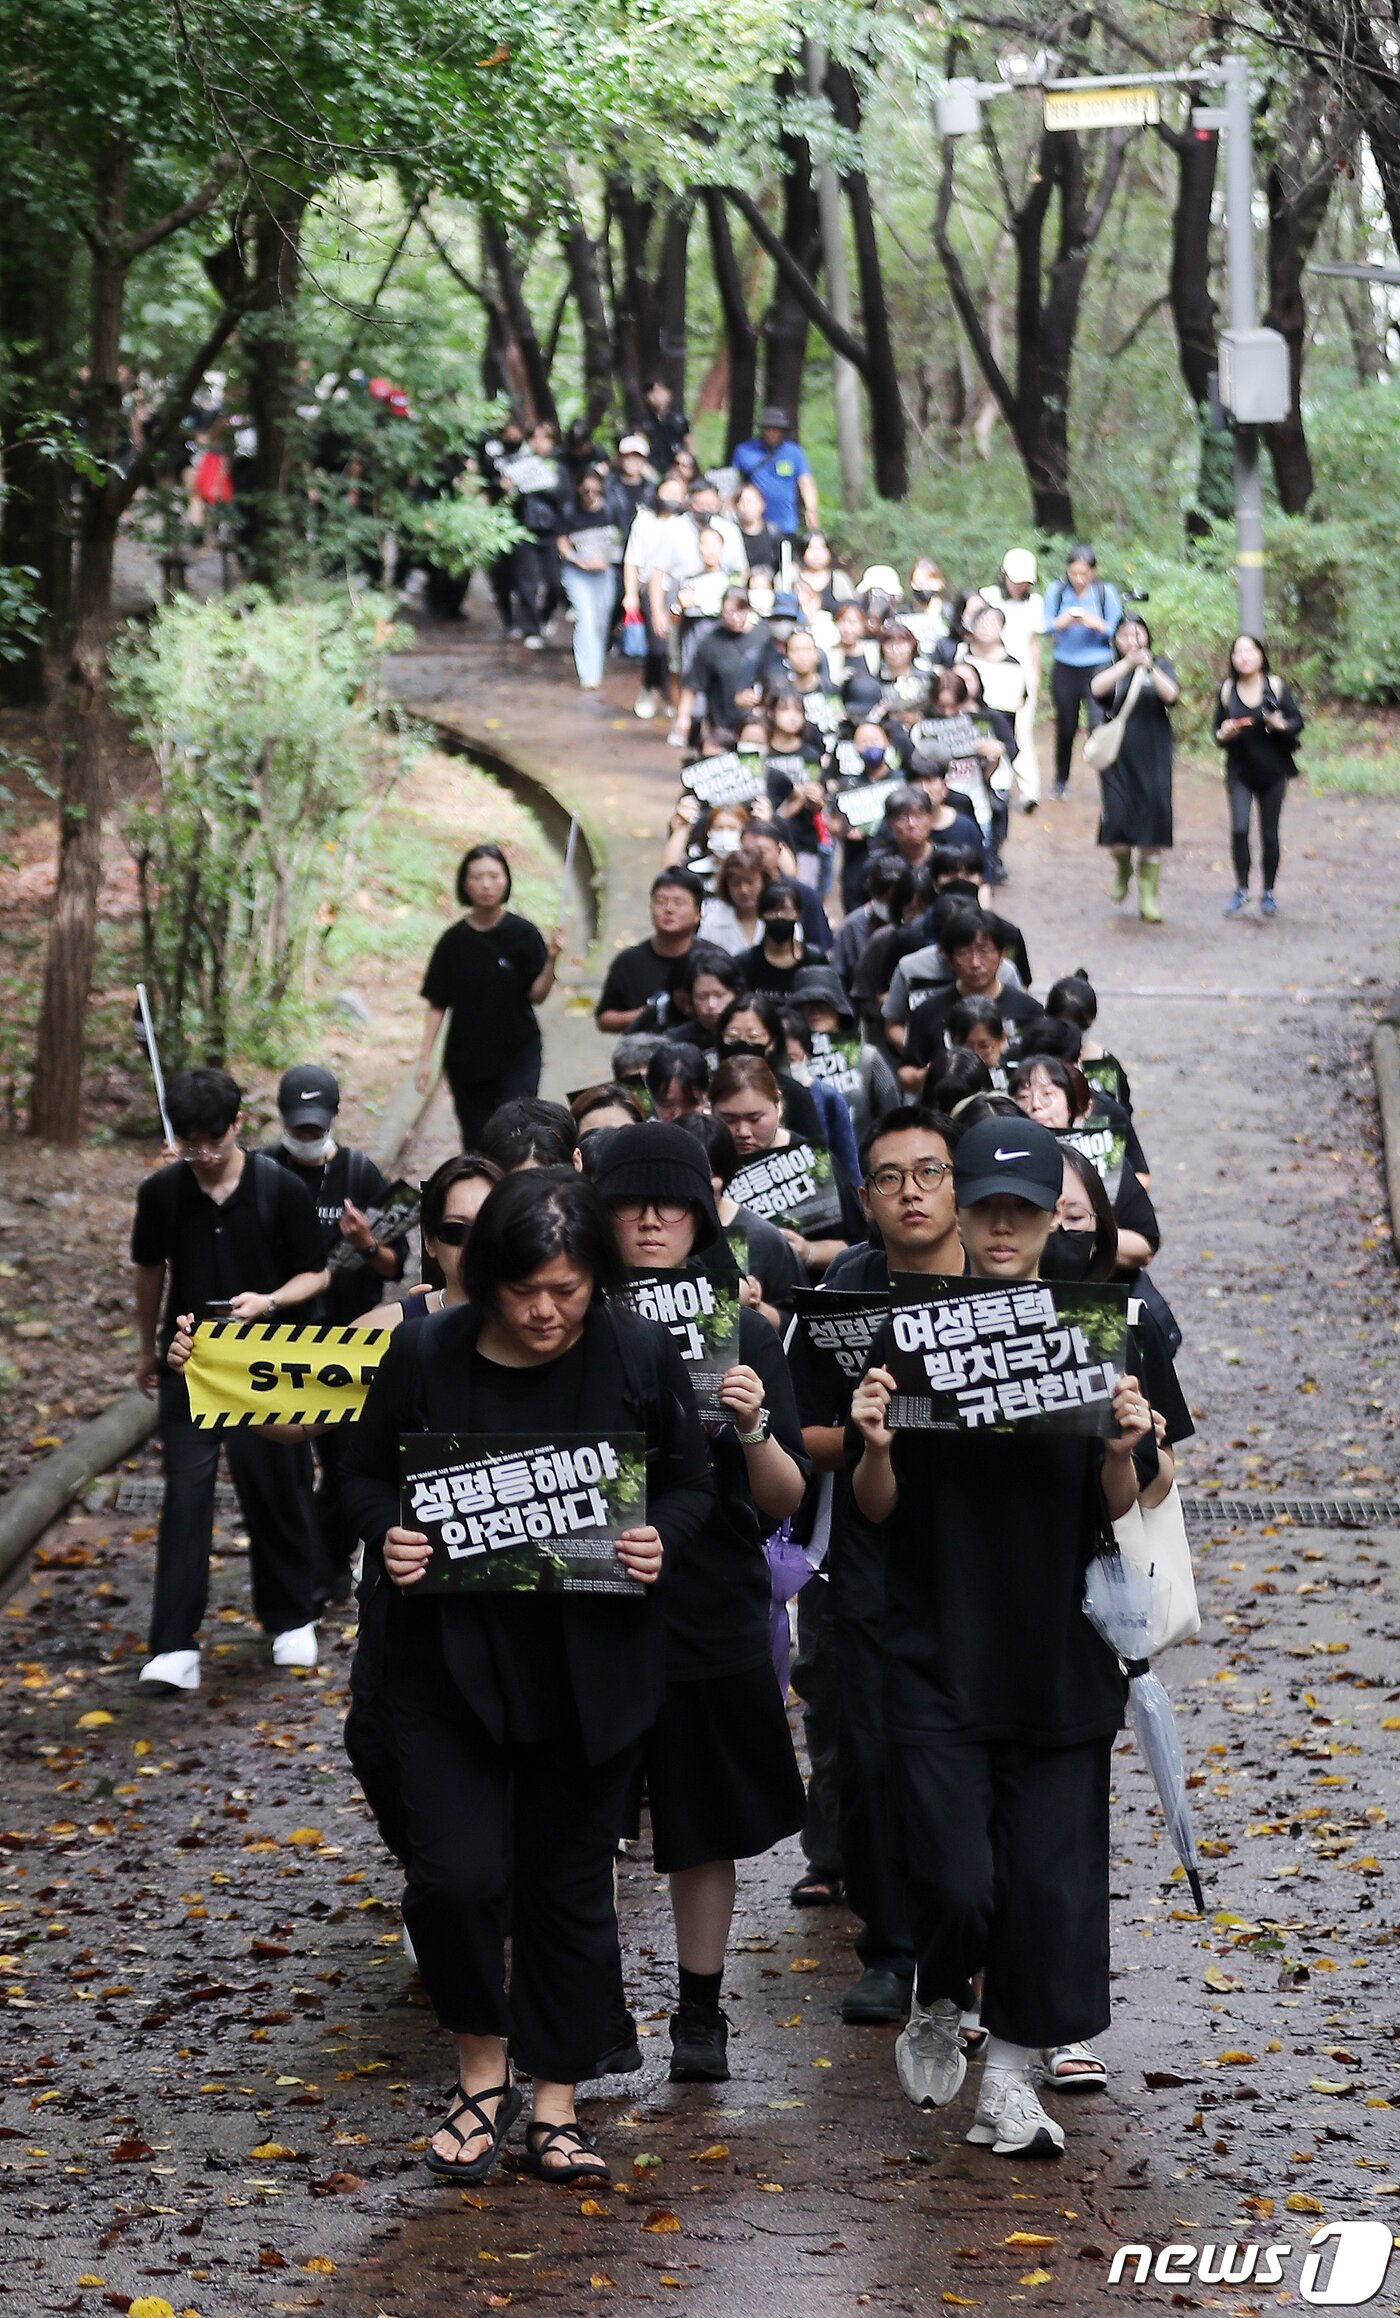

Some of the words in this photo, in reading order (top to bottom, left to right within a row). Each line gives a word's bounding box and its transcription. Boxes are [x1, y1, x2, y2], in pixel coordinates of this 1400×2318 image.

[723, 1144, 816, 1203] 평등해야
[742, 1174, 817, 1220] 전하다
[892, 1288, 1058, 1353] 여성폭력
[923, 1326, 1093, 1392] 방치국가
[956, 1361, 1121, 1428] 규탄한다
[411, 1440, 619, 1523] 성평등해야
[441, 1488, 609, 1559] 안전하다
